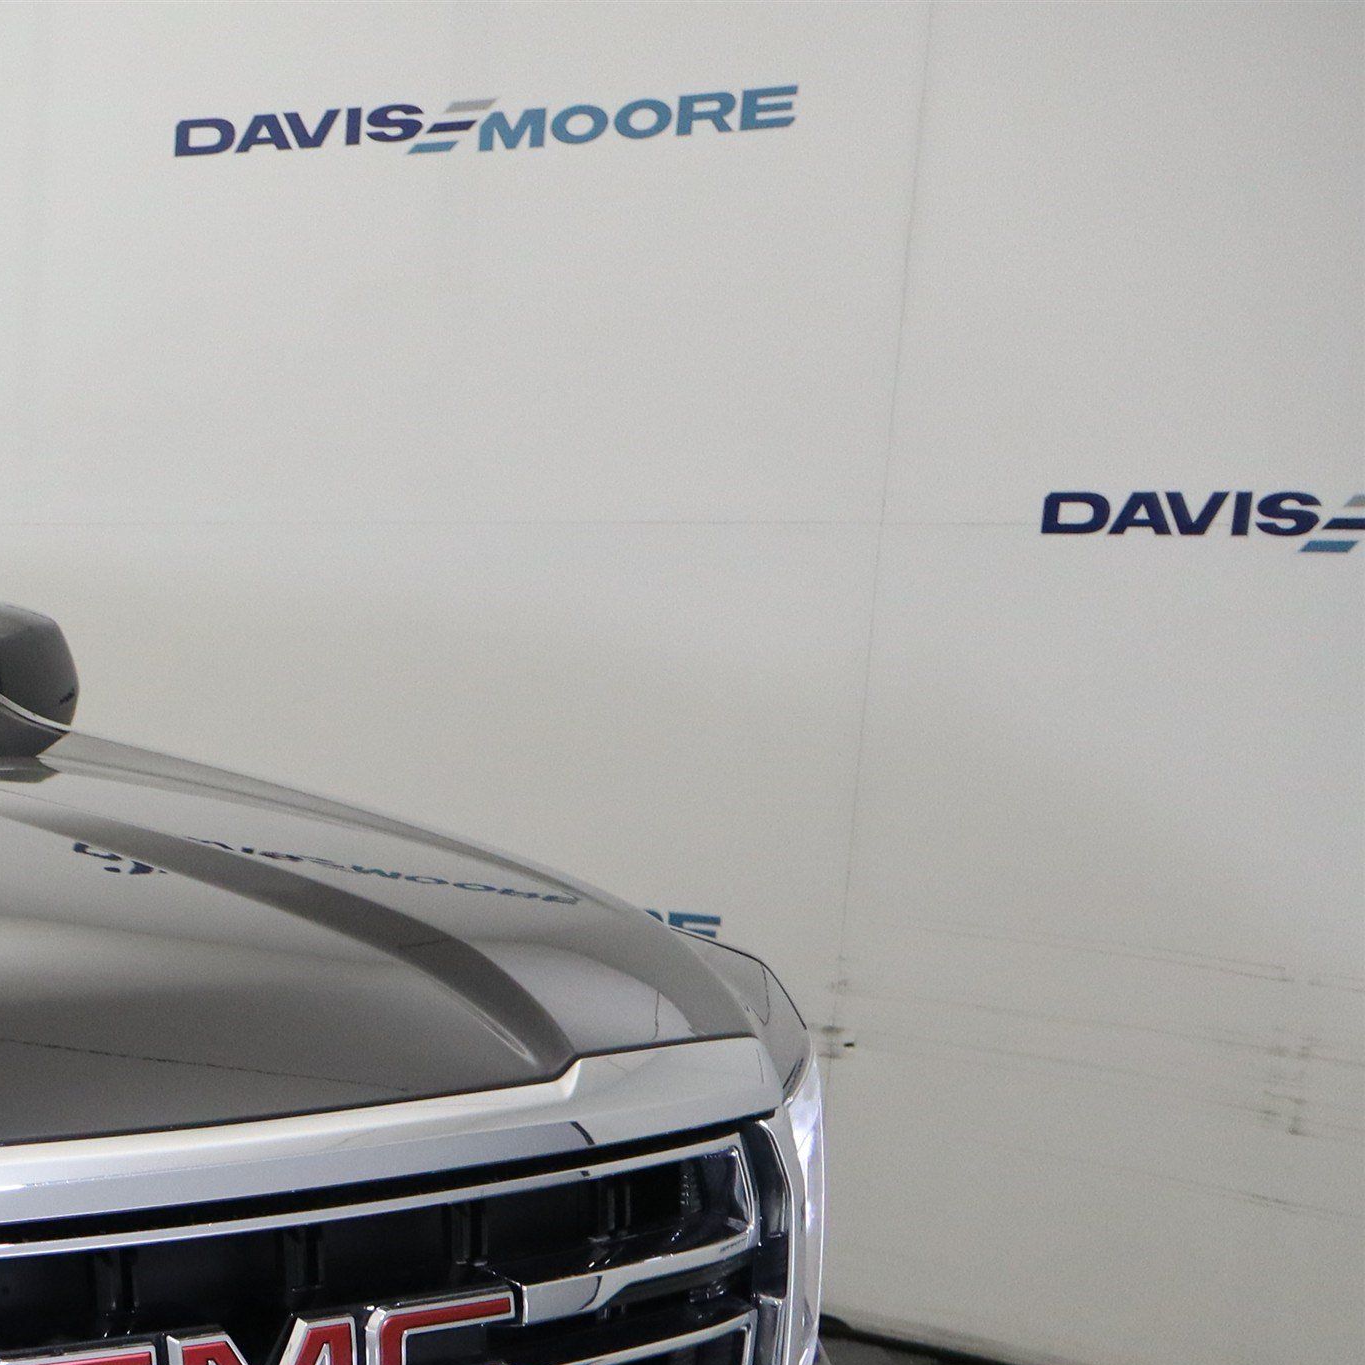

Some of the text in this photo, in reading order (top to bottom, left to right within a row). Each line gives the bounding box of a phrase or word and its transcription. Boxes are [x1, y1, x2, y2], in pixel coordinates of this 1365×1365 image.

[174, 83, 799, 154] DAVIS MOORE
[1040, 489, 1317, 534] DAVIS
